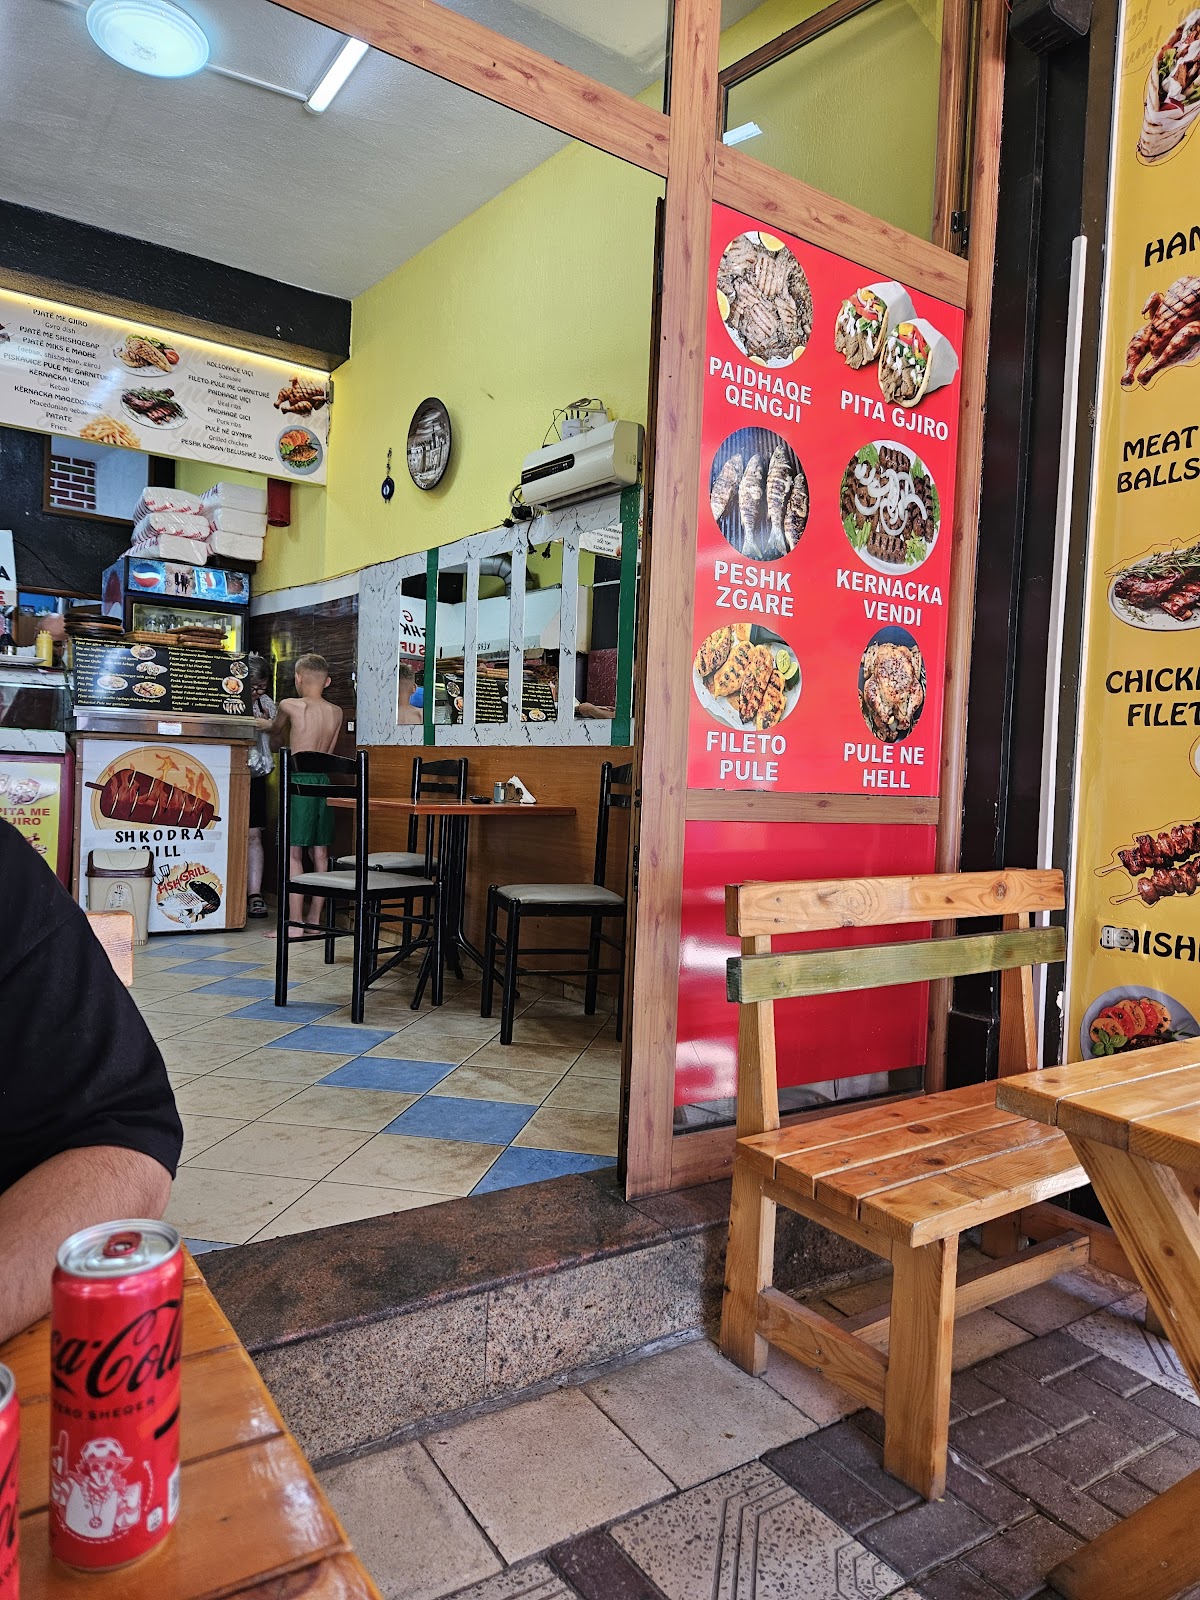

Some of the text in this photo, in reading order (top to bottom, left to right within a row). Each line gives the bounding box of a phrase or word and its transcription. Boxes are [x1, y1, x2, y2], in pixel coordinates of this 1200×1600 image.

[56, 314, 66, 322] ME
[42, 331, 54, 339] ME
[71, 348, 96, 360] MADHE
[62, 366, 74, 374] ME
[188, 374, 210, 384] FILETO
[708, 356, 812, 405] PAIDHAQE
[725, 384, 801, 424] QENGJI
[840, 390, 949, 441] PITA GJIRO
[46, 412, 72, 422] PATATE
[1123, 426, 1199, 462] MEAT
[1117, 457, 1200, 494] BALLS
[714, 560, 792, 593] PESHK
[836, 568, 943, 606] KERNACKA
[715, 585, 794, 618] ZGARE
[862, 599, 922, 627] VENDI
[1106, 667, 1200, 694] CHICK
[1128, 702, 1200, 726] FILET
[706, 730, 787, 755] FILETO
[843, 742, 925, 766] PULE NE
[720, 759, 779, 782] PULE
[862, 768, 911, 789] HELL
[4, 817, 42, 826] JIRO
[30, 808, 50, 816] ME
[114, 828, 204, 843] SHKODRA
[128, 845, 181, 858] ILL
[180, 865, 210, 882] GRILL
[157, 878, 182, 894] FISH
